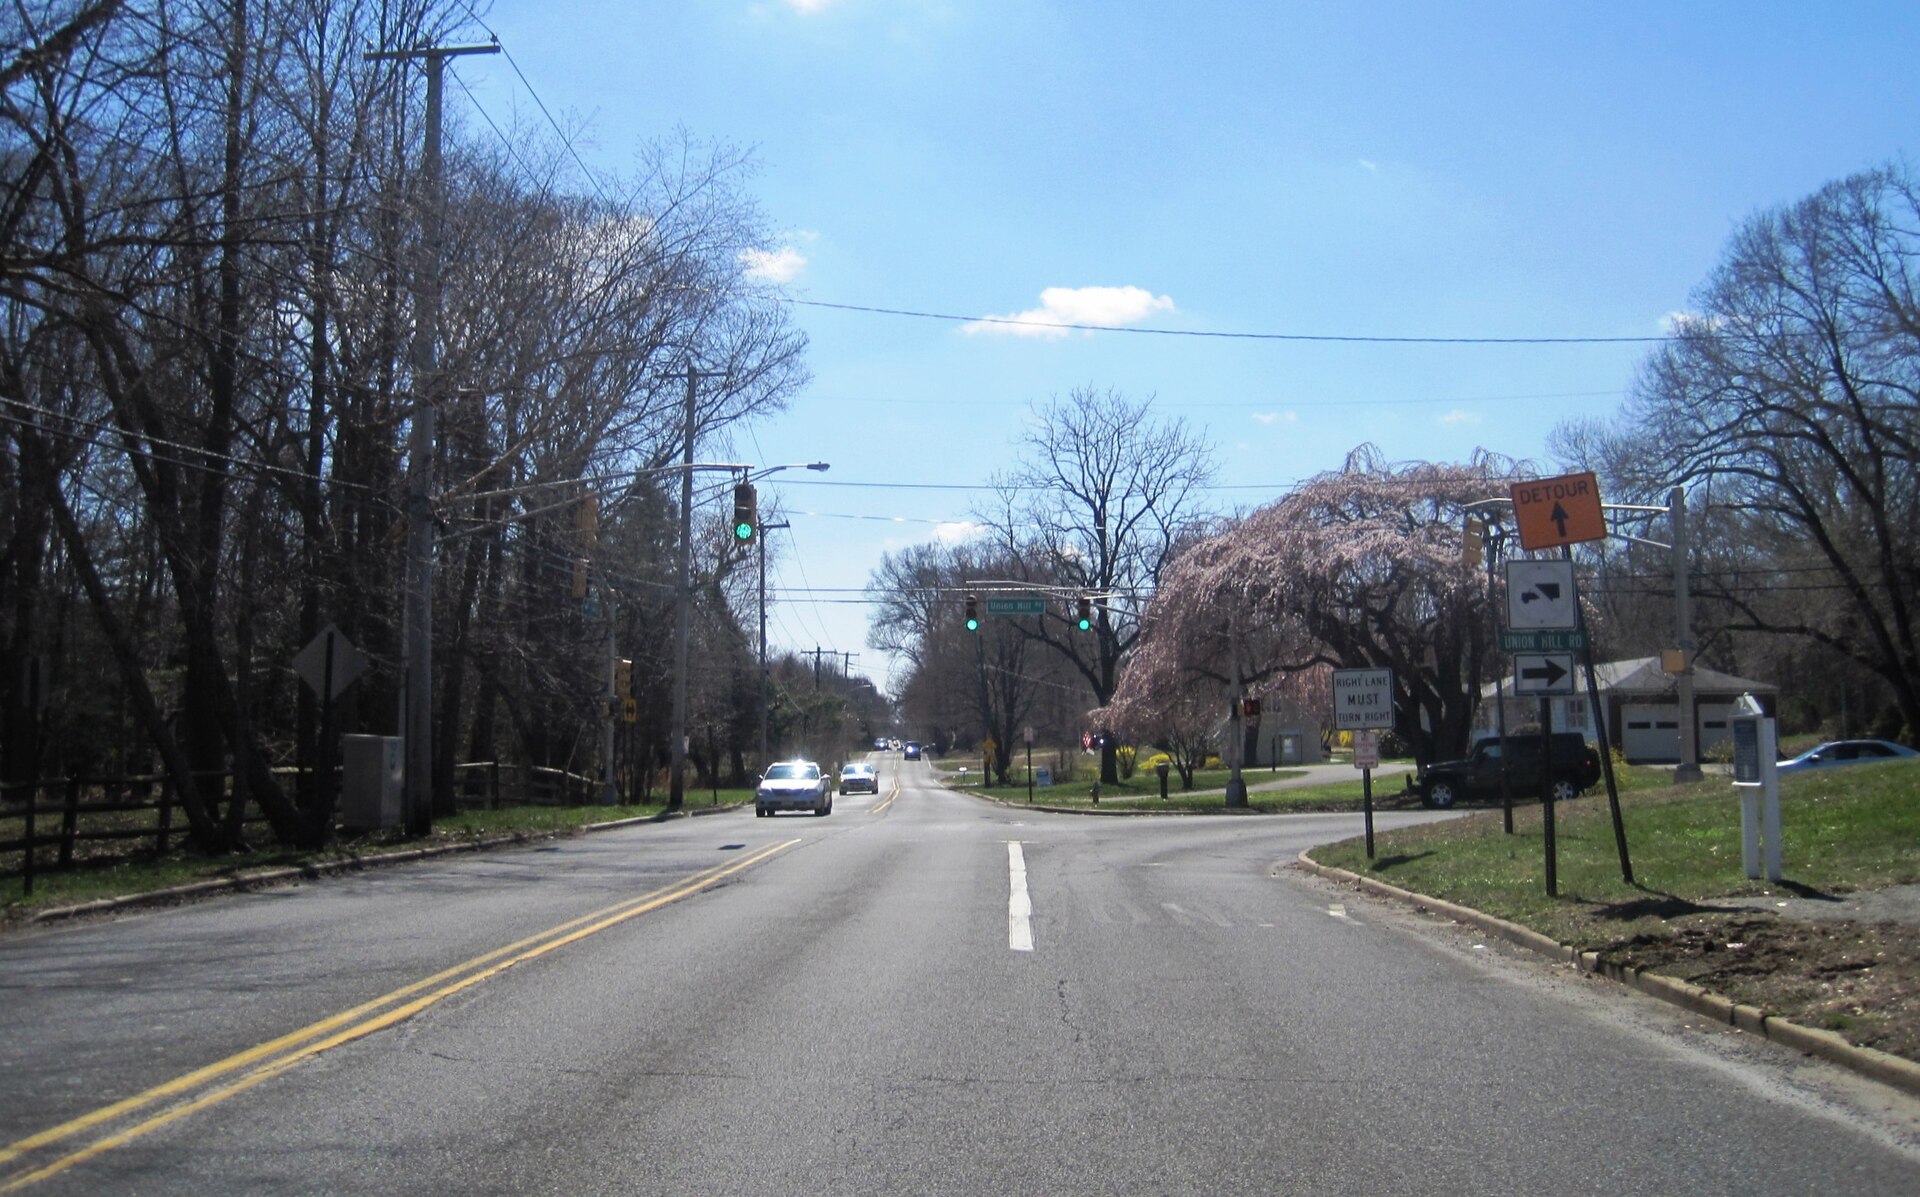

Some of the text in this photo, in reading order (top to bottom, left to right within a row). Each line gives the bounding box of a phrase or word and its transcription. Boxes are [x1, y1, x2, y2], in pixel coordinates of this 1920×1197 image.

[1519, 479, 1590, 505] DETOUR
[990, 601, 1014, 610] Union
[1017, 601, 1031, 610] Hill
[1504, 634, 1582, 649] UNION HILL RD
[1336, 676, 1388, 688] RIGHT LANE
[1347, 693, 1378, 705] MUST
[1338, 711, 1390, 722] TURN RIGHT
